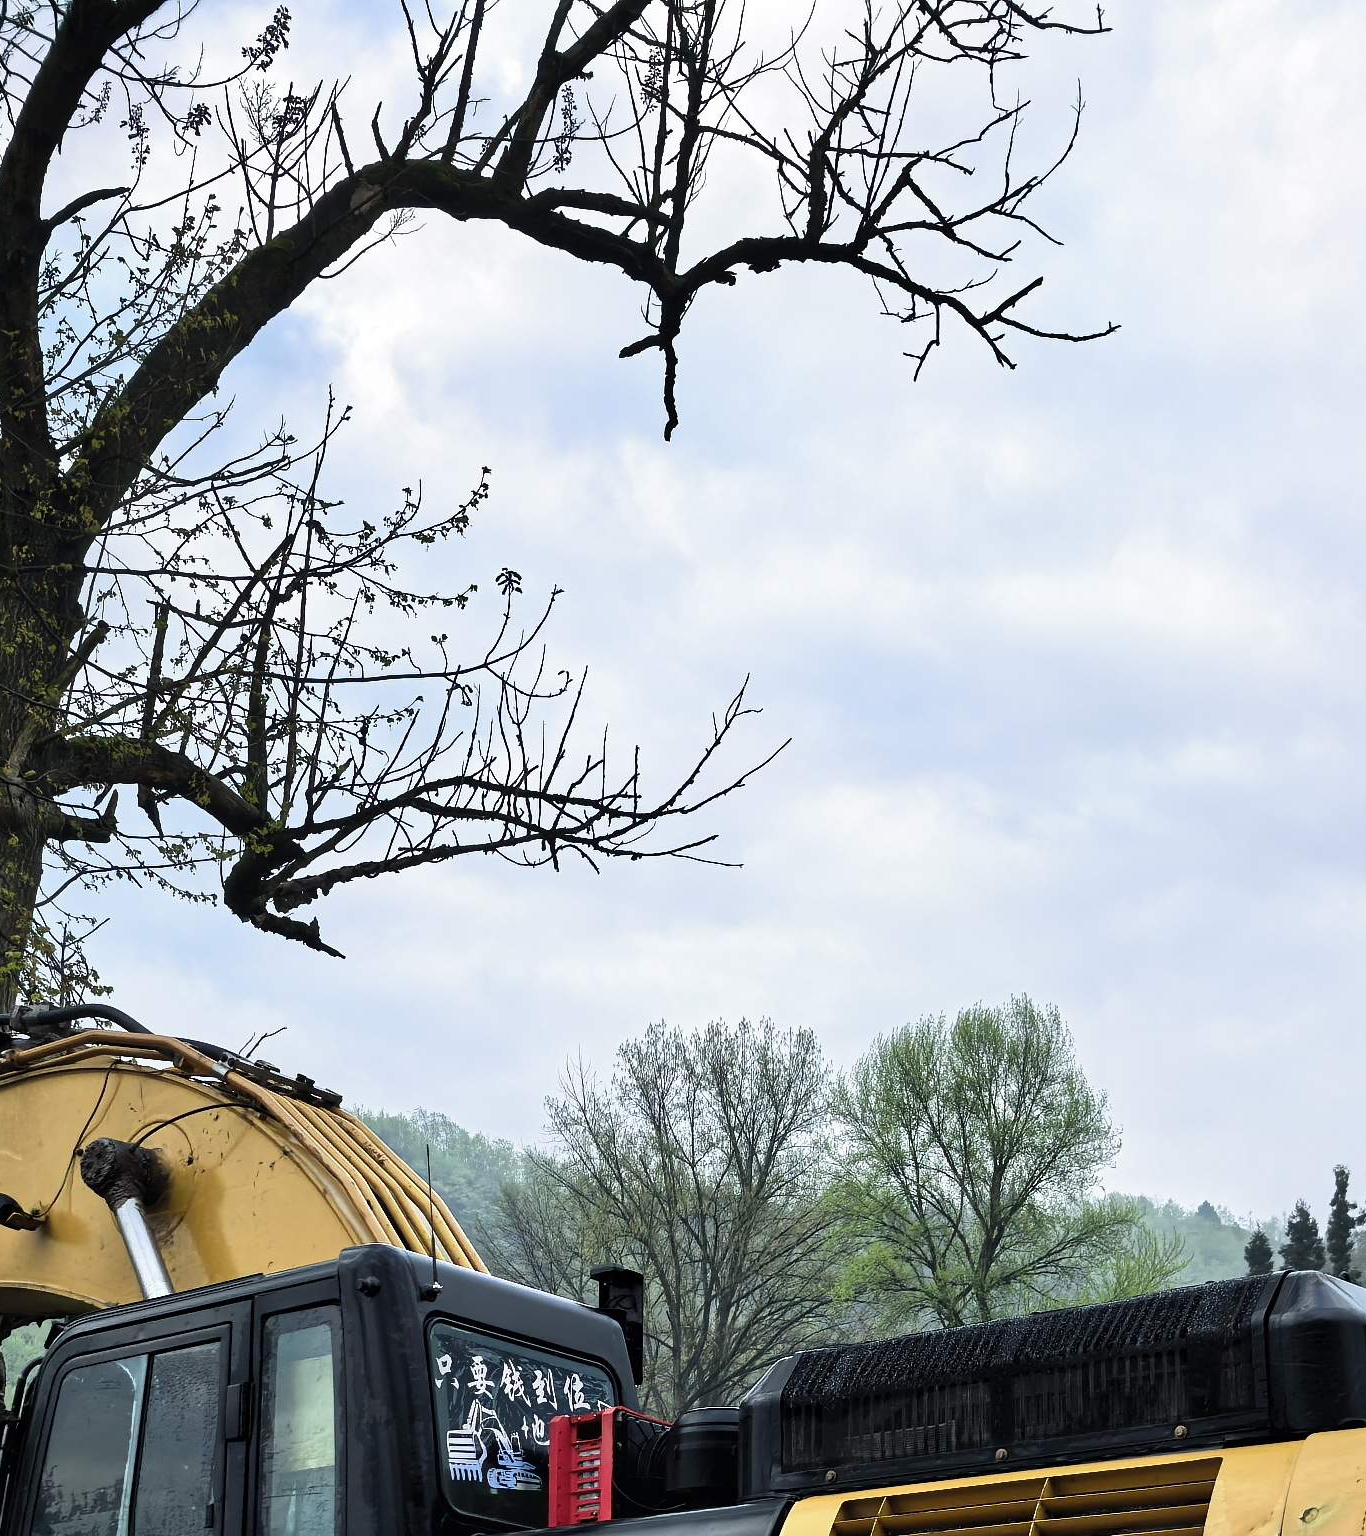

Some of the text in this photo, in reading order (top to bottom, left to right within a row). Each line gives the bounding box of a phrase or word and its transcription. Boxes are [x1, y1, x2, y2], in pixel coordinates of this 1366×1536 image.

[435, 1353, 592, 1412] 只要钱到位
